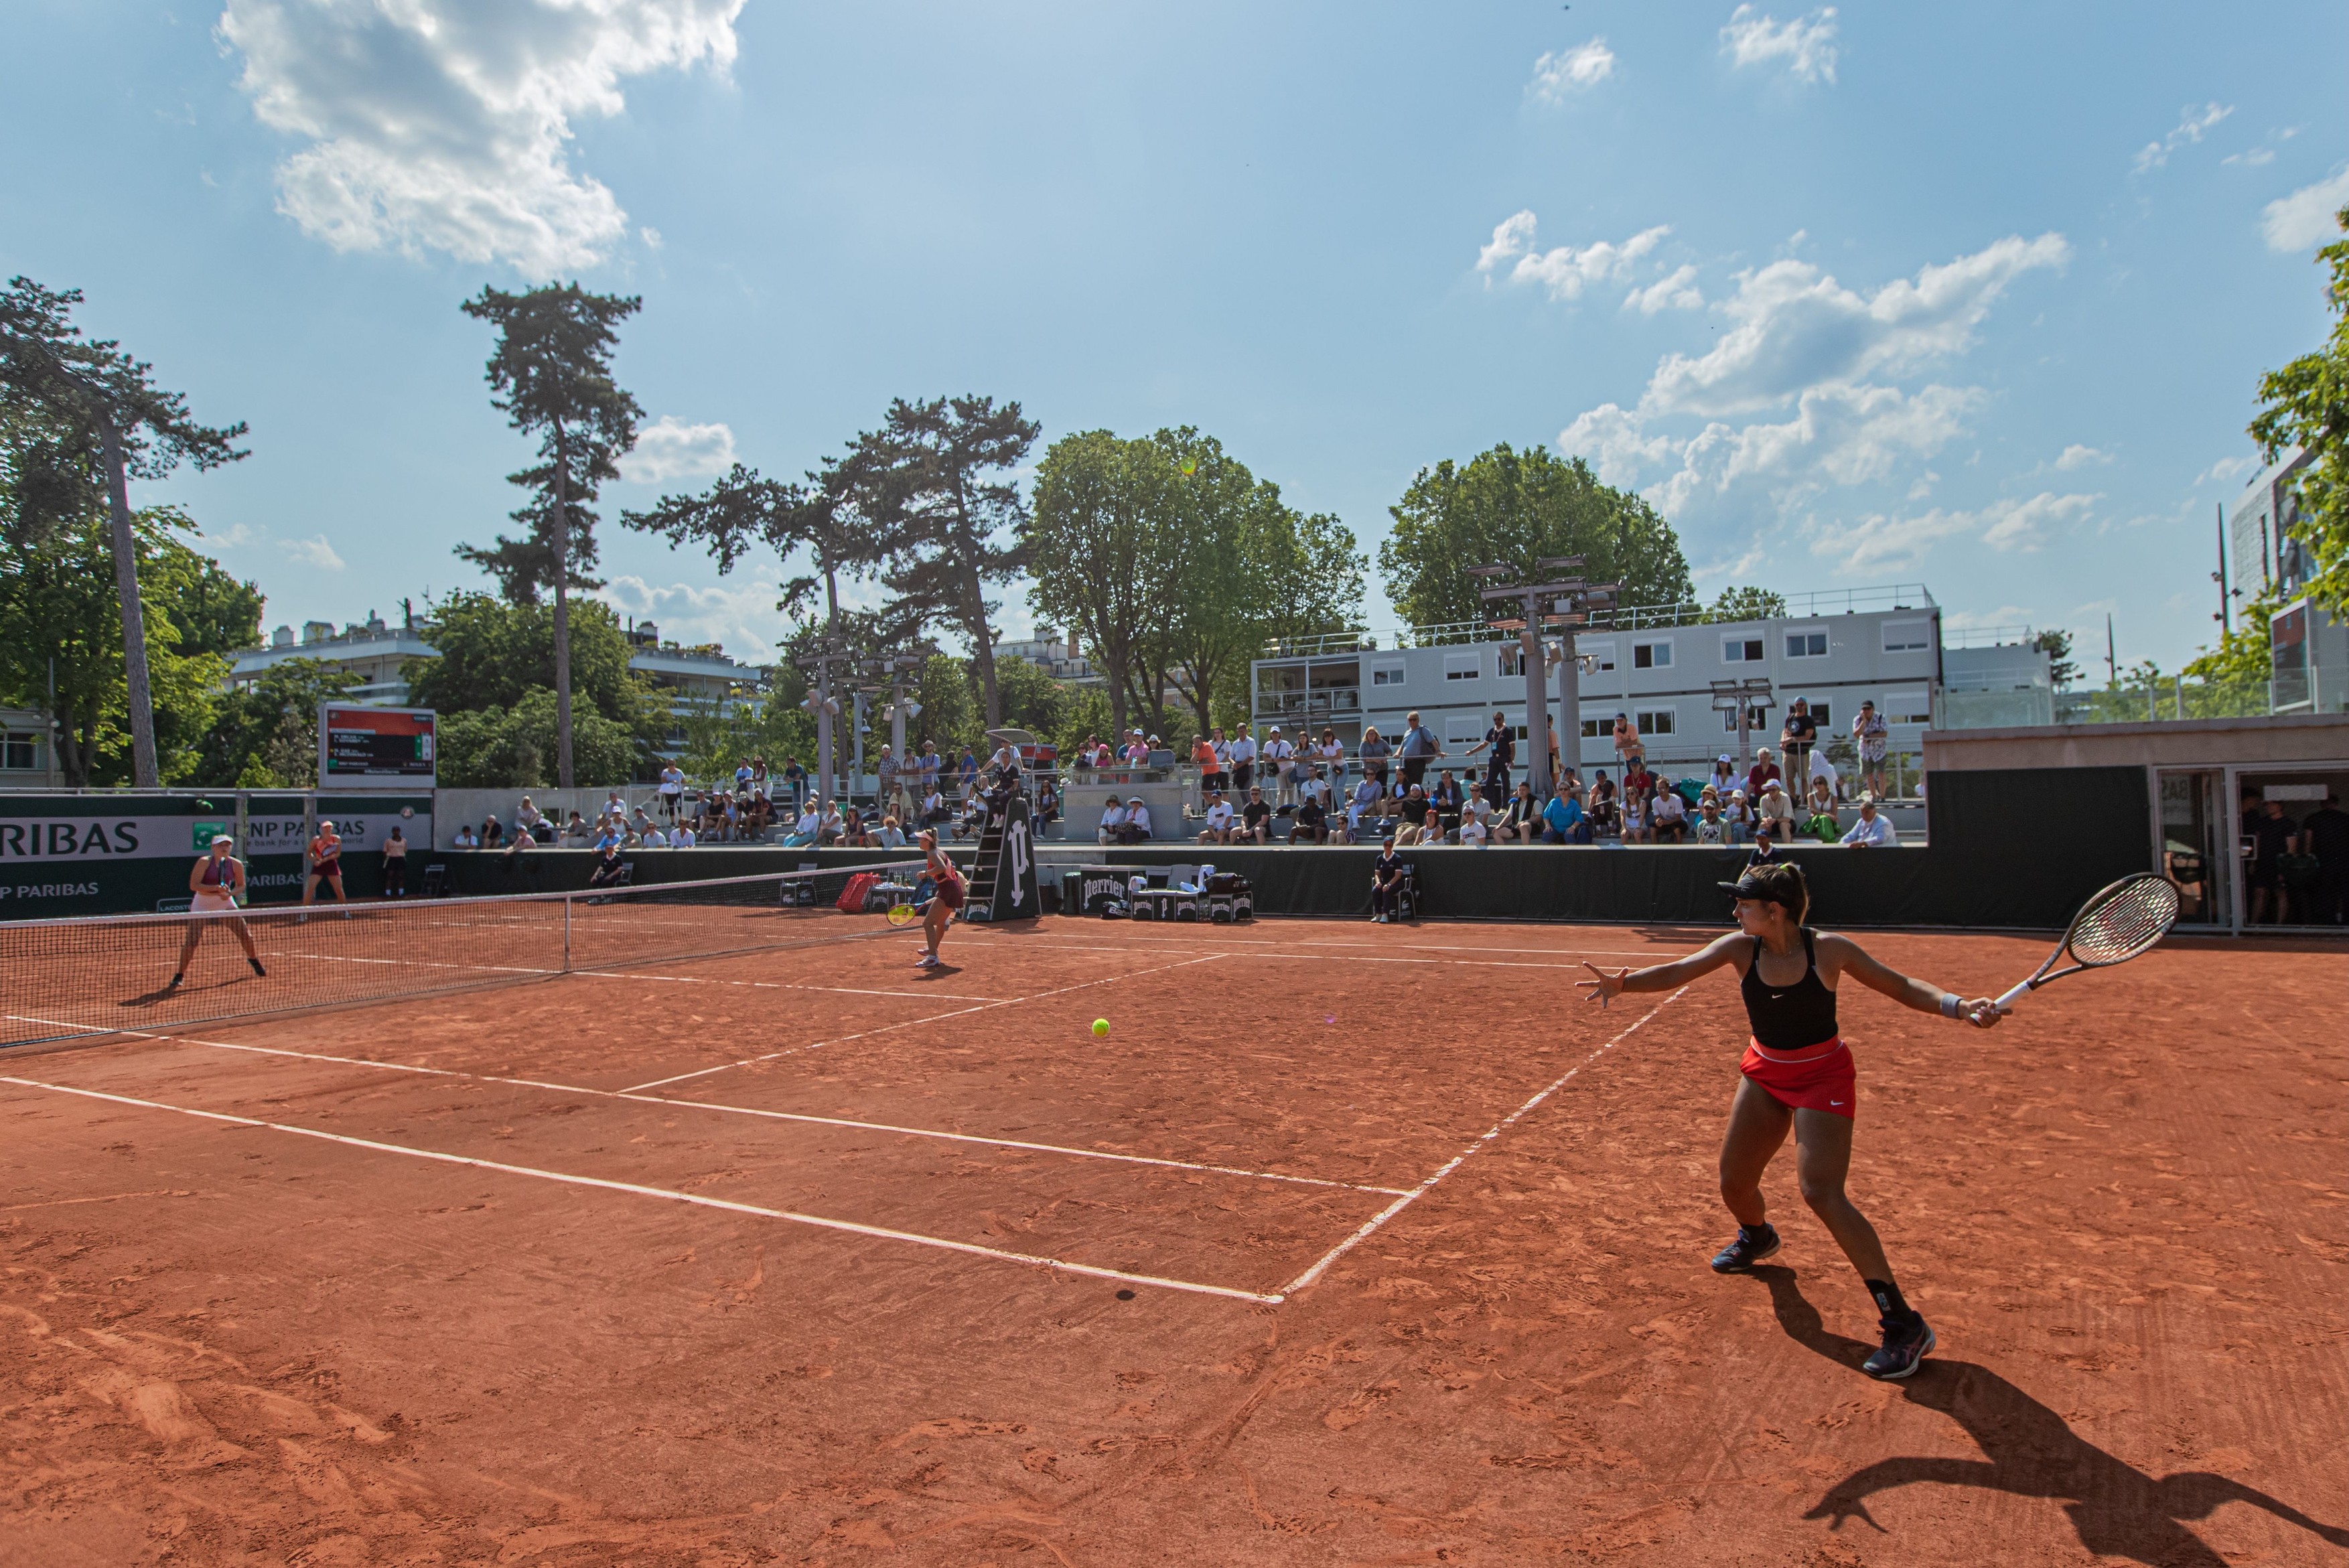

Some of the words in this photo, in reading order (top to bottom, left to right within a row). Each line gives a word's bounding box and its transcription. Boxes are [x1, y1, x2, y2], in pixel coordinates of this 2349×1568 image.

[255, 839, 275, 847] bank
[279, 838, 291, 848] for
[17, 882, 99, 898] PARIBAS
[1084, 875, 1125, 909] perrier
[967, 902, 989, 920] perrier
[1134, 900, 1152, 915] perrier
[1177, 900, 1196, 916] perrier
[1212, 902, 1230, 917] perrier
[1233, 894, 1251, 920] perrier
